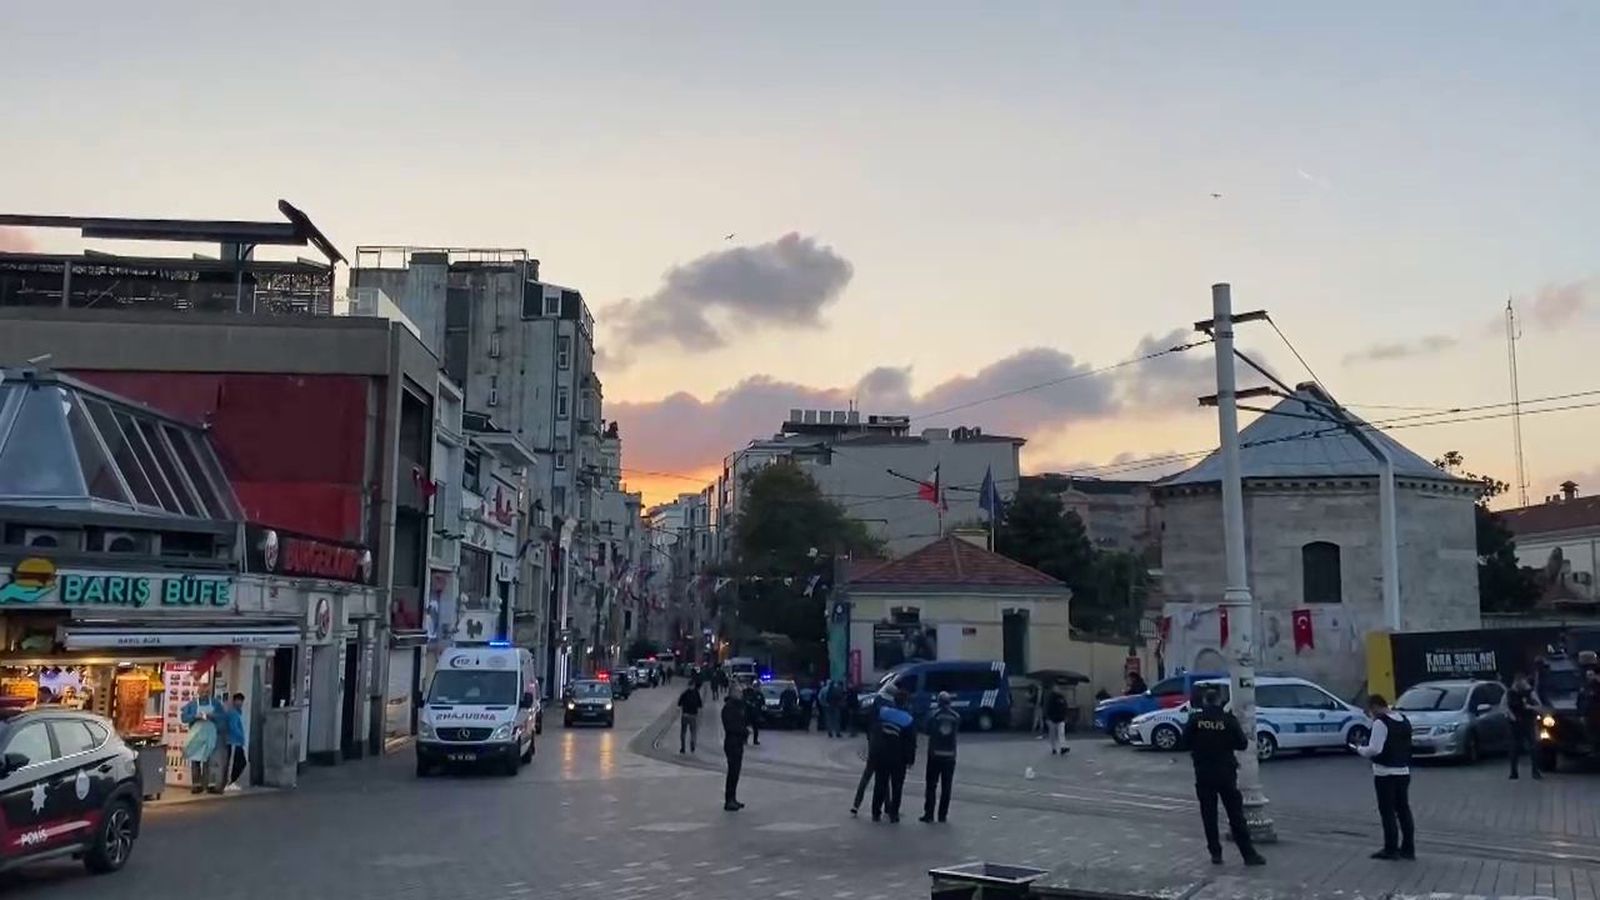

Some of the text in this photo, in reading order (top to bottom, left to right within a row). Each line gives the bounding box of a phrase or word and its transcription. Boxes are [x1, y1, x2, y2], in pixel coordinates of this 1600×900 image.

[62, 574, 231, 607] BARIŞ BÜFE
[1425, 650, 1497, 671] KARA SURLARI
